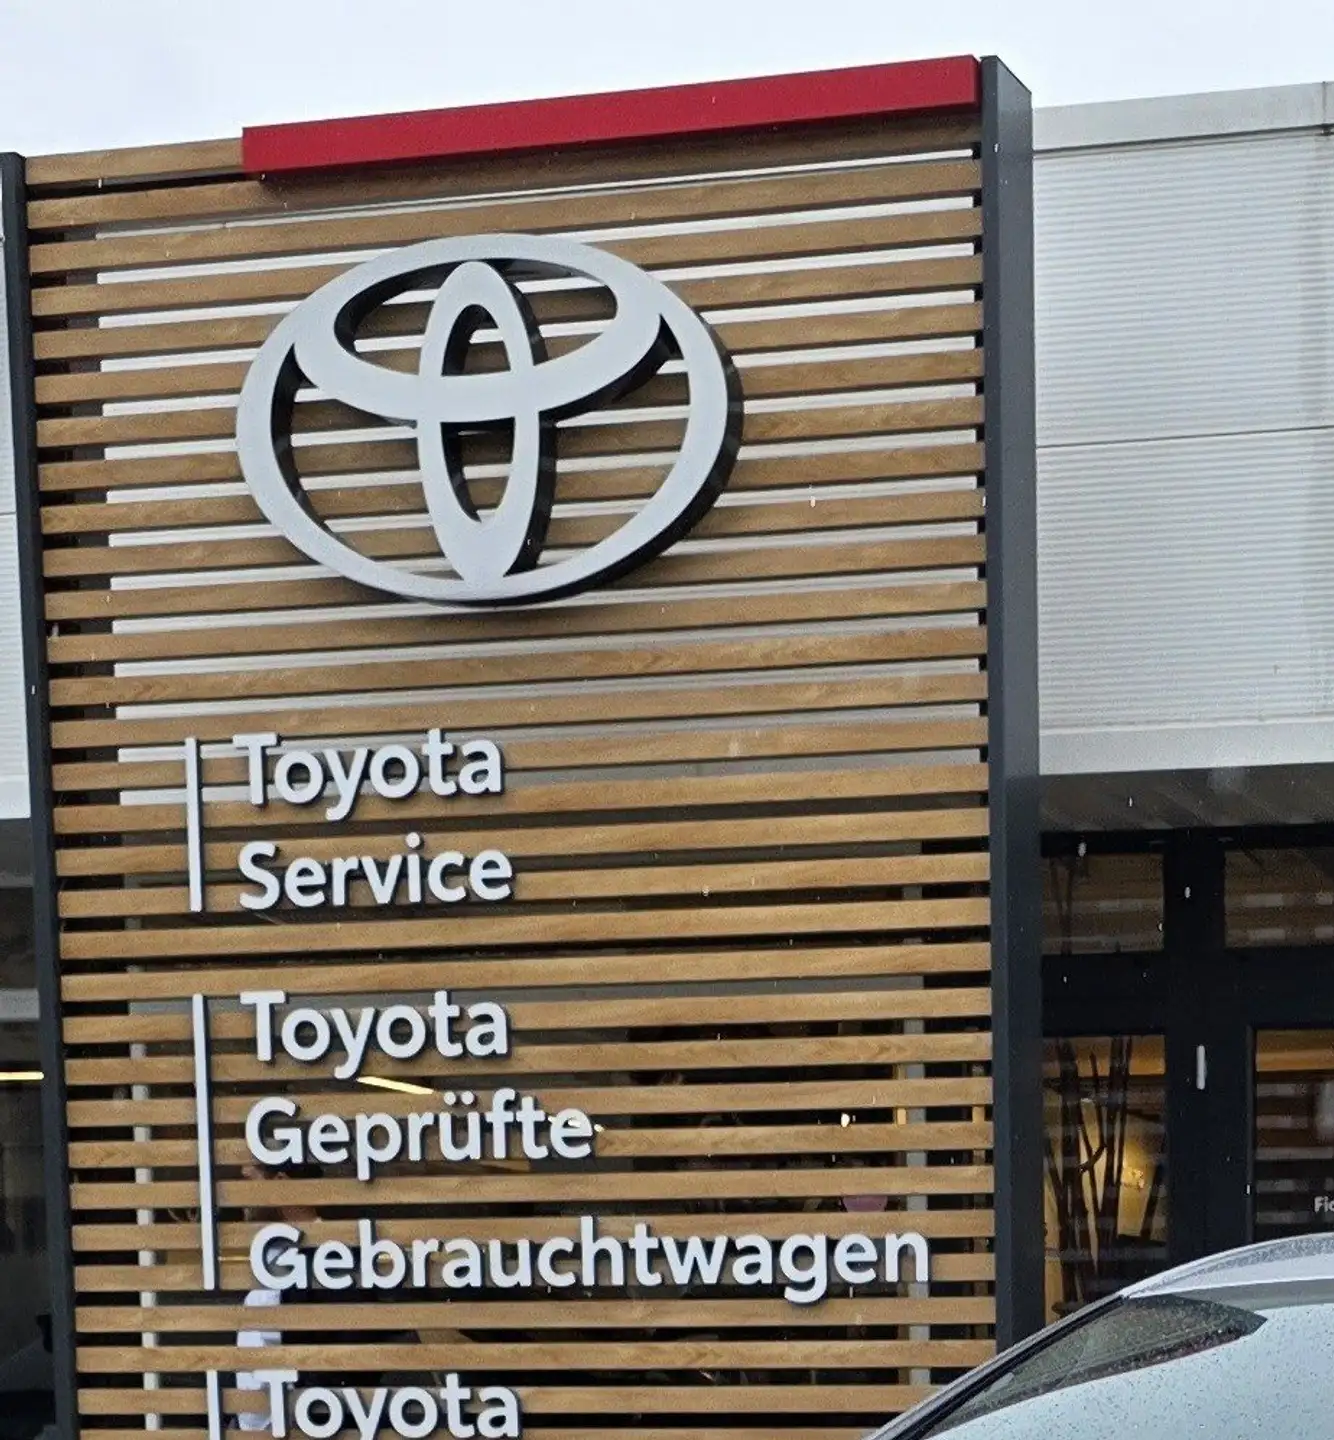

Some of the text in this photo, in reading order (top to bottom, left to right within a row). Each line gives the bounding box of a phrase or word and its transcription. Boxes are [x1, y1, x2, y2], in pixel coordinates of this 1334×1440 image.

[233, 728, 502, 821] Toyota
[238, 832, 513, 910] Service
[240, 991, 508, 1080] Toyota
[245, 1088, 593, 1180] Geprüfte
[249, 1216, 929, 1304] Gebrauchtwagen
